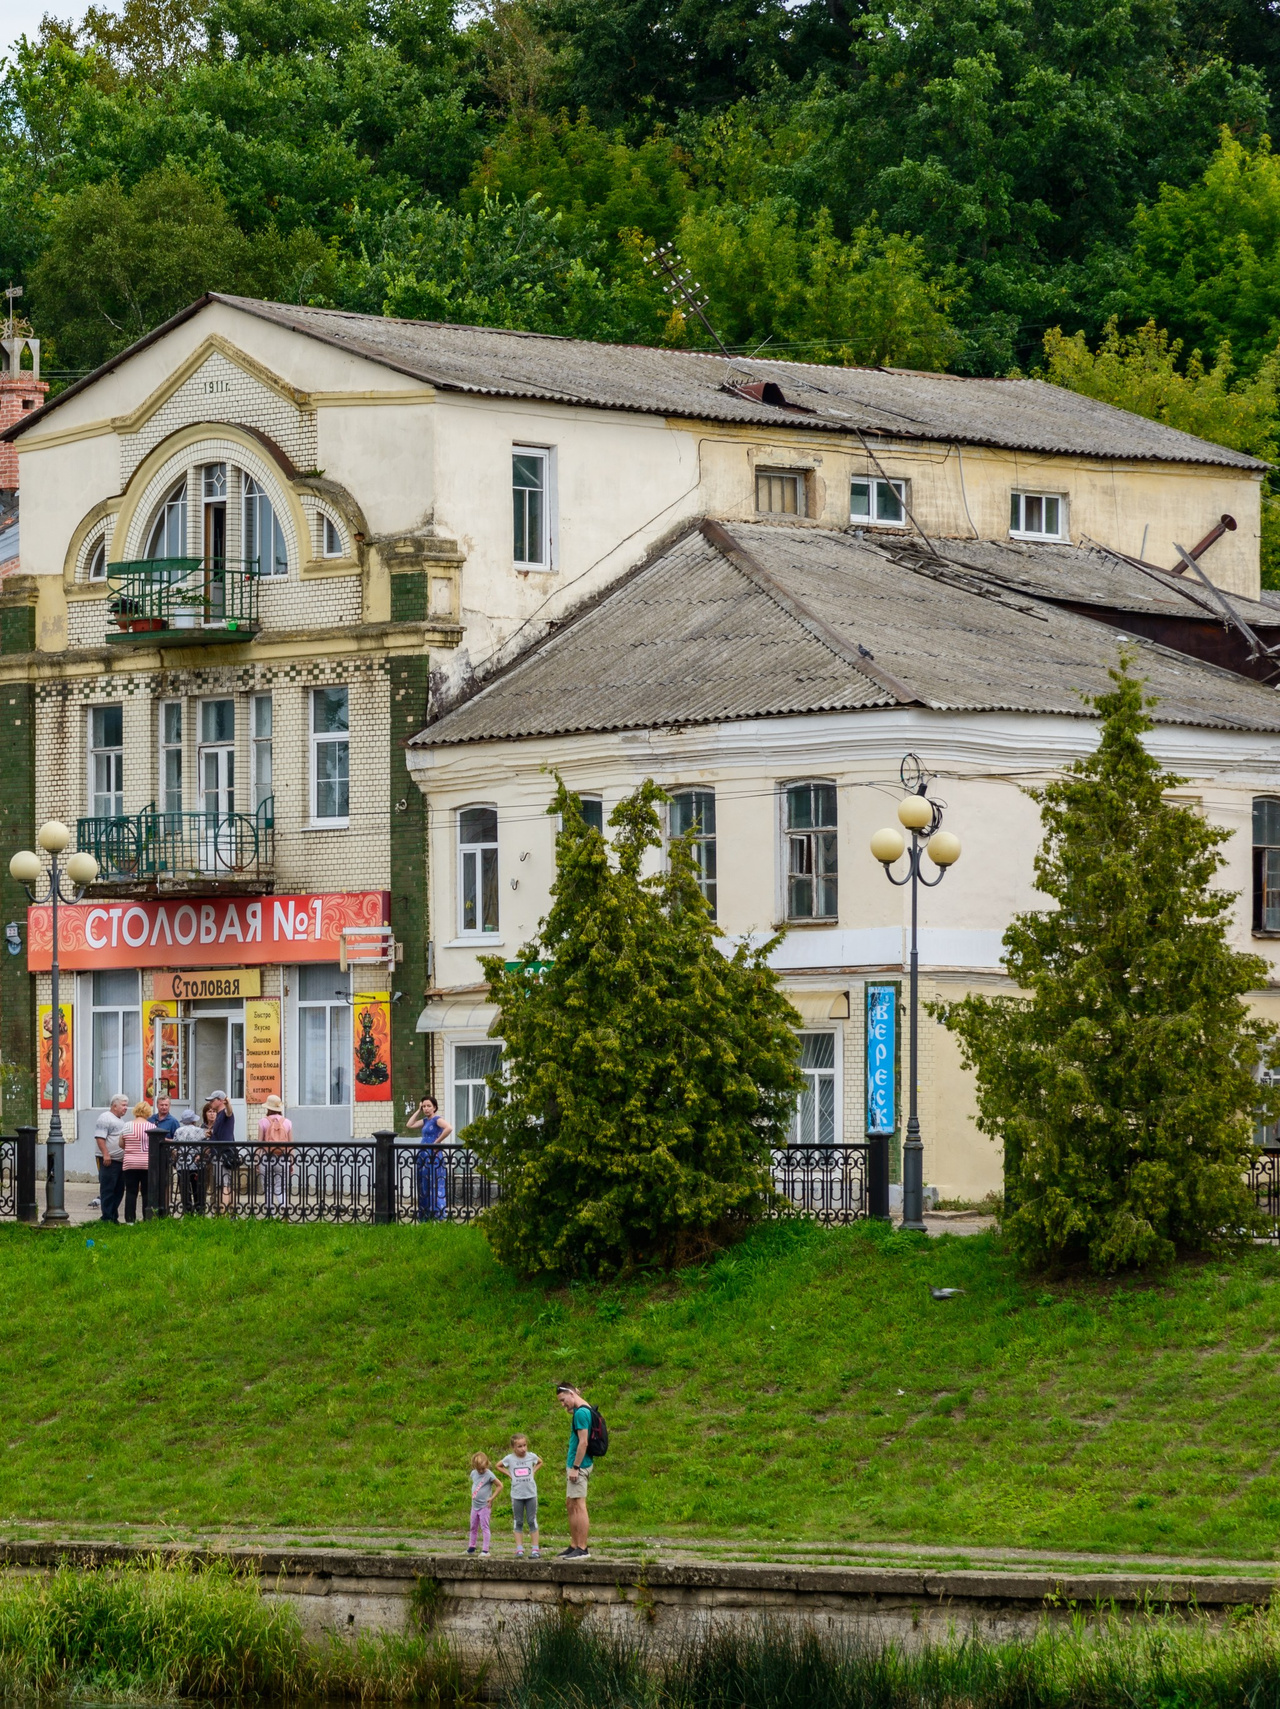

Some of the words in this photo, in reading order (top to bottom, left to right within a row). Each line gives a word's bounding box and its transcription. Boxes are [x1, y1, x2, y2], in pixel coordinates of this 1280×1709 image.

[204, 381, 223, 394] 1911
[85, 902, 262, 949] СТОЛОВАЯ
[172, 974, 240, 999] Столовая
[254, 1011, 271, 1019] Быстро
[254, 1023, 271, 1032] Вкусно
[874, 1005, 888, 1125] ВЕРЕСК
